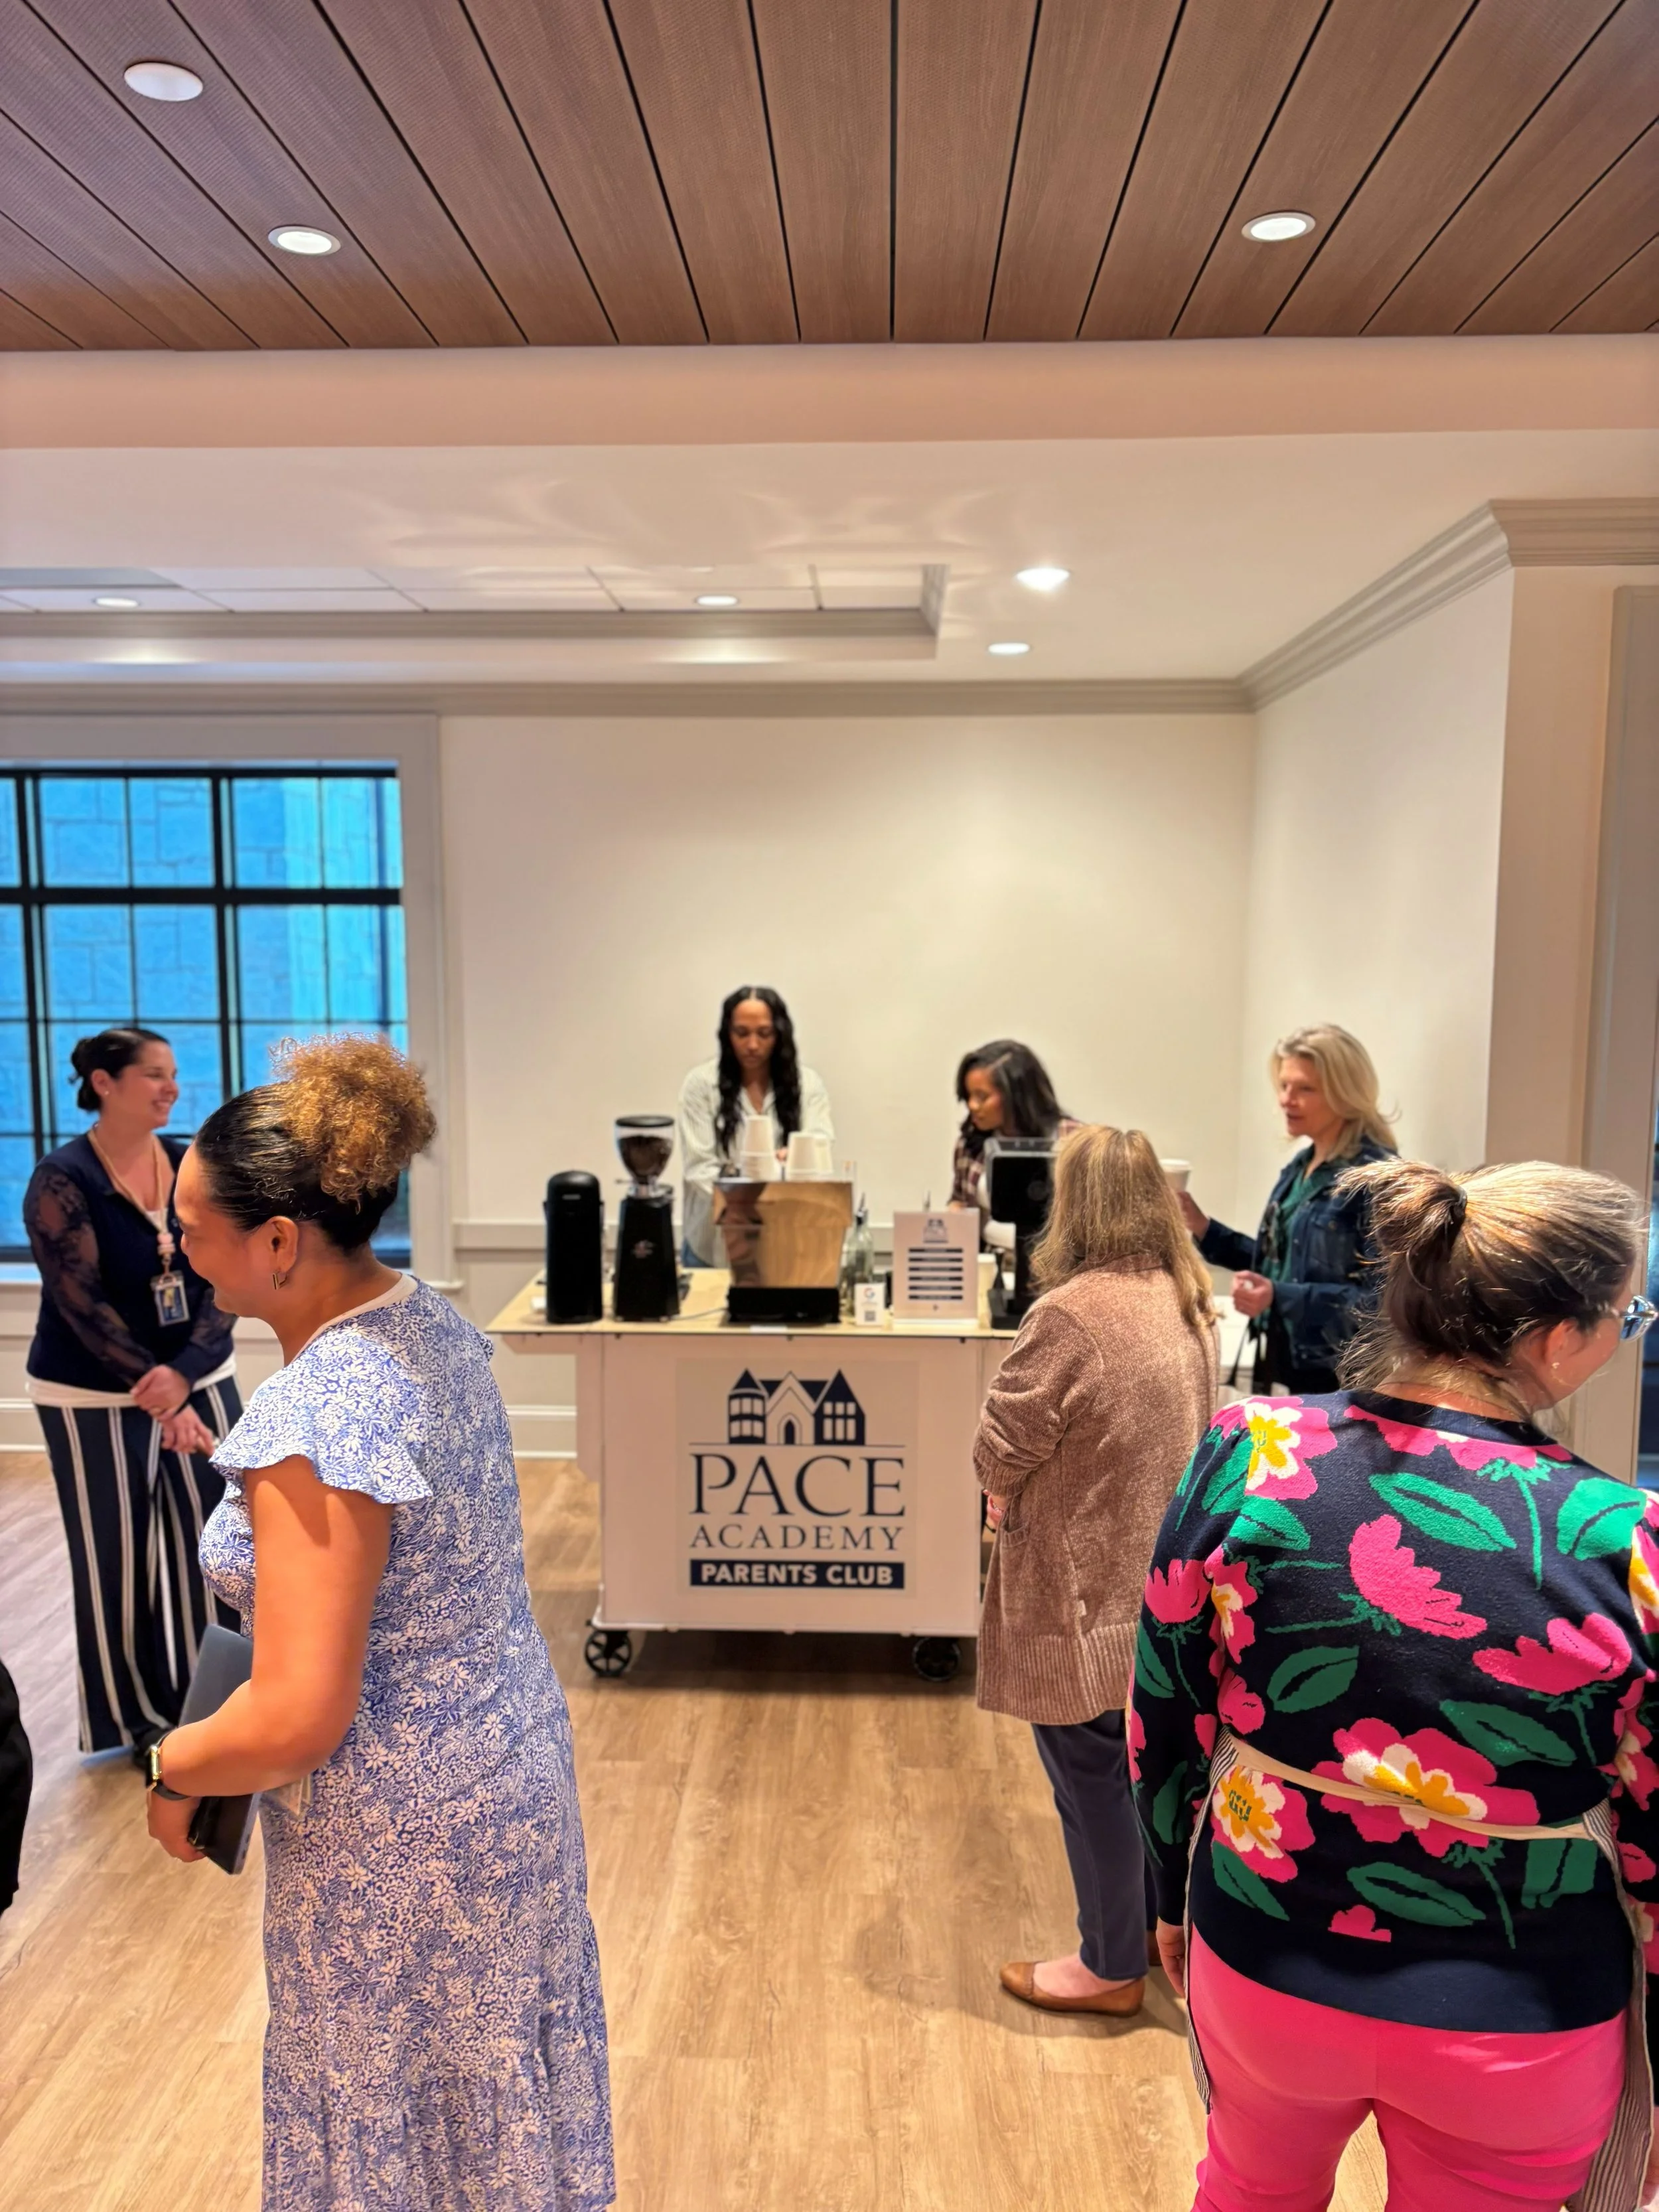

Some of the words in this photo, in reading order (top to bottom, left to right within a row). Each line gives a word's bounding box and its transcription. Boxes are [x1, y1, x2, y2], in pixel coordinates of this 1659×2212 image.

[689, 1453, 904, 1517] PACE
[689, 1524, 903, 1551] ACADEMY
[701, 1564, 817, 1584] PARENTS
[826, 1565, 893, 1585] CLUB
